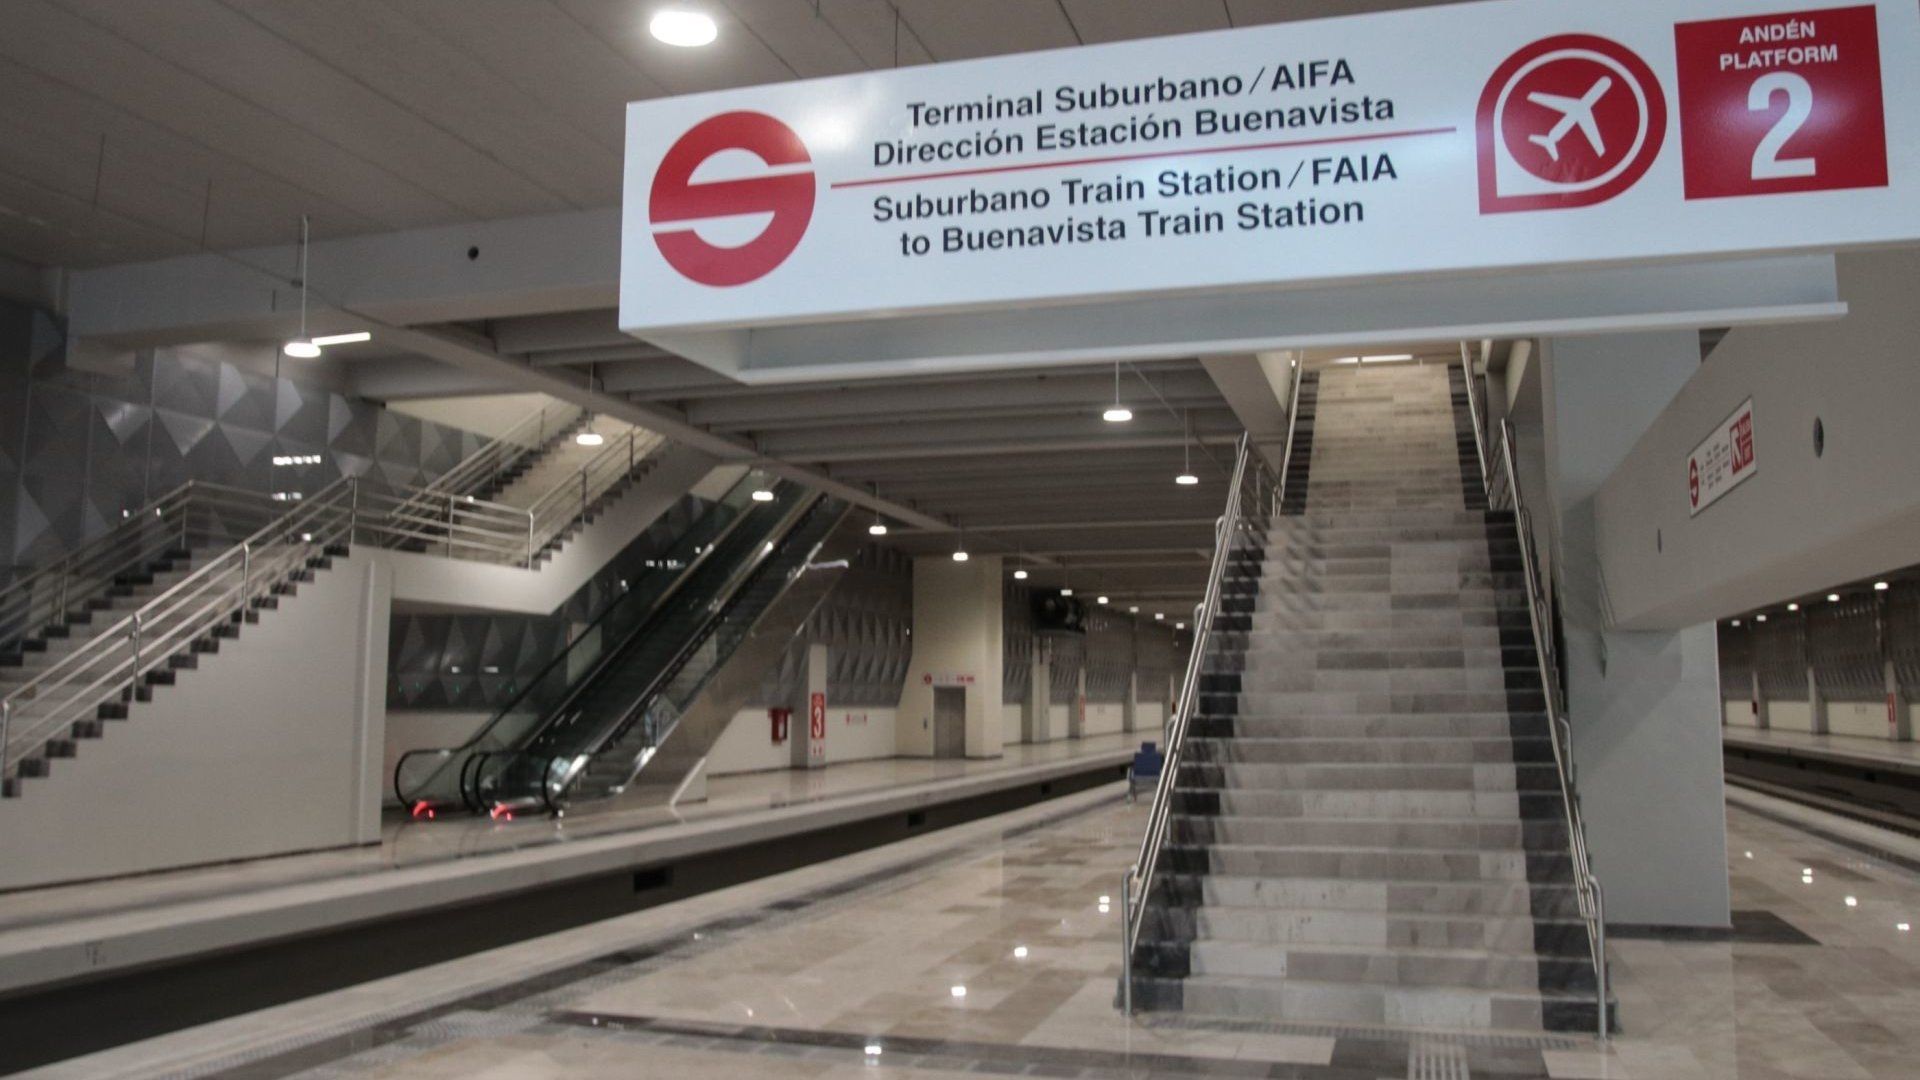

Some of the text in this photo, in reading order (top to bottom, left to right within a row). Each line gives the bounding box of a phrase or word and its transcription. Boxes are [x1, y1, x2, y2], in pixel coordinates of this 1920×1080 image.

[1739, 19, 1815, 43] ANDÉN
[1720, 45, 1839, 71] PLATFORM
[906, 89, 1042, 128] Terminal
[1746, 72, 1816, 180] 2
[874, 95, 1395, 167] Dirección Estación Buenavista
[873, 187, 1050, 222] Suburbano
[1061, 180, 1145, 205] Train
[900, 197, 1364, 256] to Buenavista Train Station
[813, 706, 822, 737] 3
